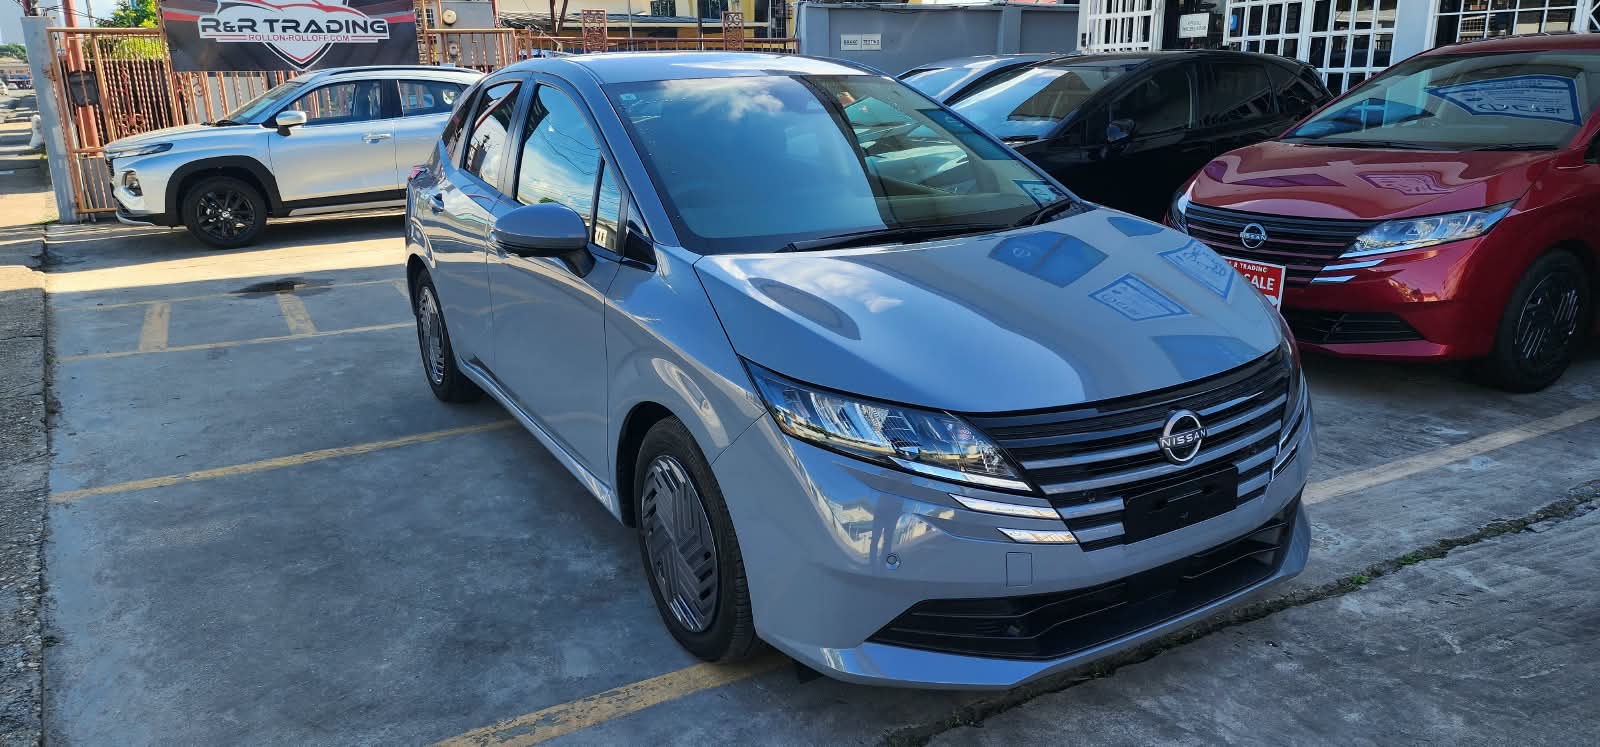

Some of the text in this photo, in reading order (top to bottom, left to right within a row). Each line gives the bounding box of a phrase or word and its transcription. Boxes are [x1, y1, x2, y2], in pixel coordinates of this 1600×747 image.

[201, 17, 388, 34] R&R TRADING
[248, 34, 350, 42] ROLLON-ROLLOFF.COM
[1240, 231, 1267, 241] NISSAN
[1240, 262, 1268, 273] TRADING
[1161, 428, 1206, 448] NISSAN
